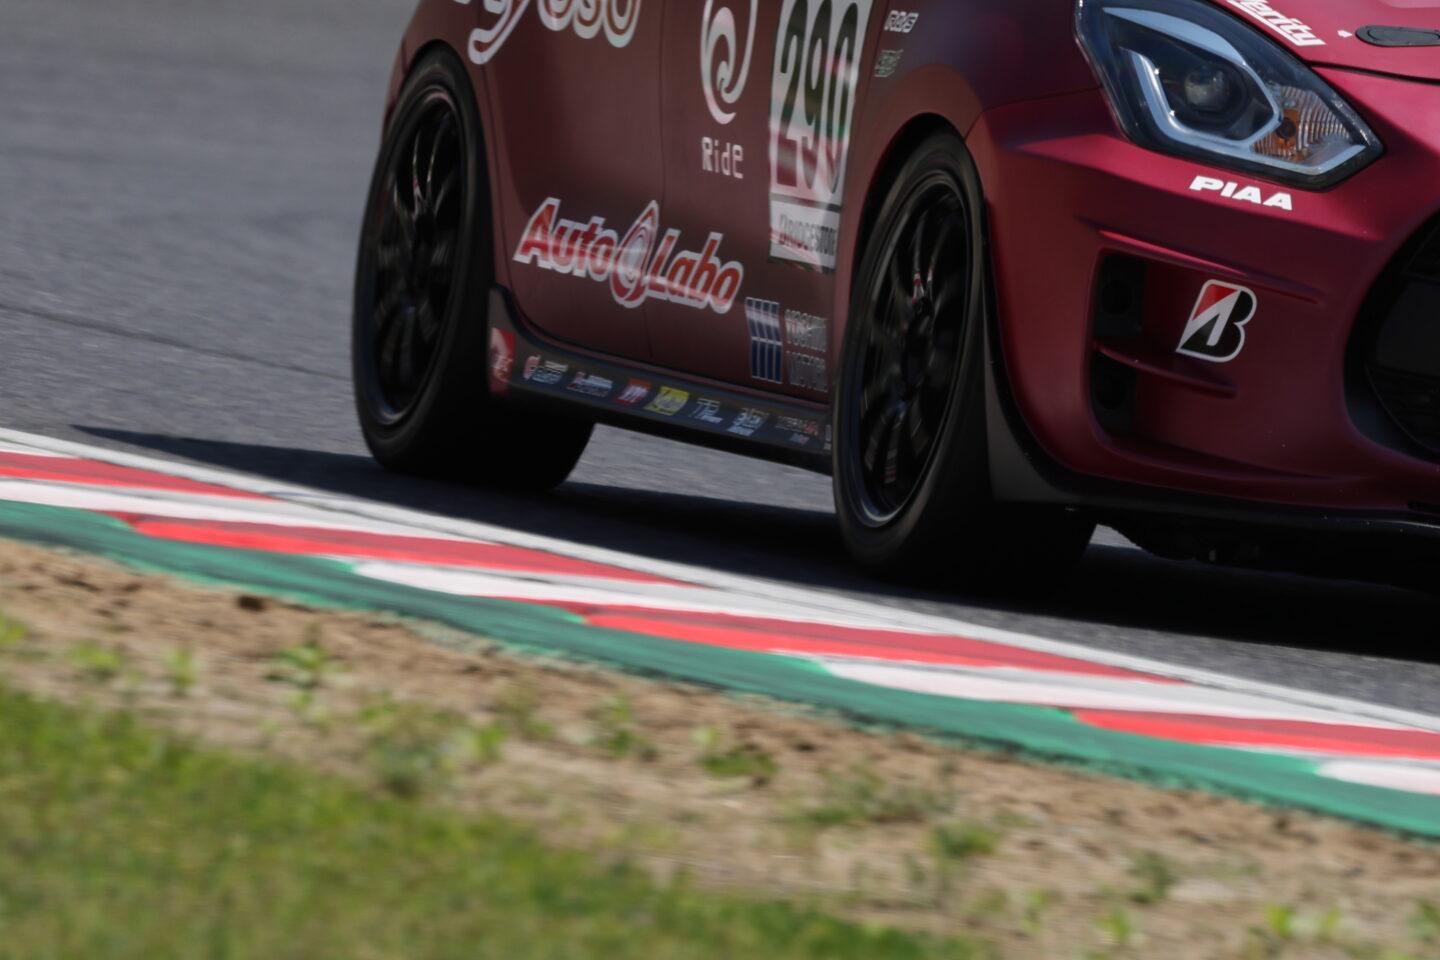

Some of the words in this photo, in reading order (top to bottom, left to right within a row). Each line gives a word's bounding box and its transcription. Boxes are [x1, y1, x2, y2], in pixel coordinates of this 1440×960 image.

[701, 136, 744, 179] Ride
[1189, 175, 1293, 211] PIAA
[513, 197, 617, 282] Auto
[646, 229, 744, 314] Labo
